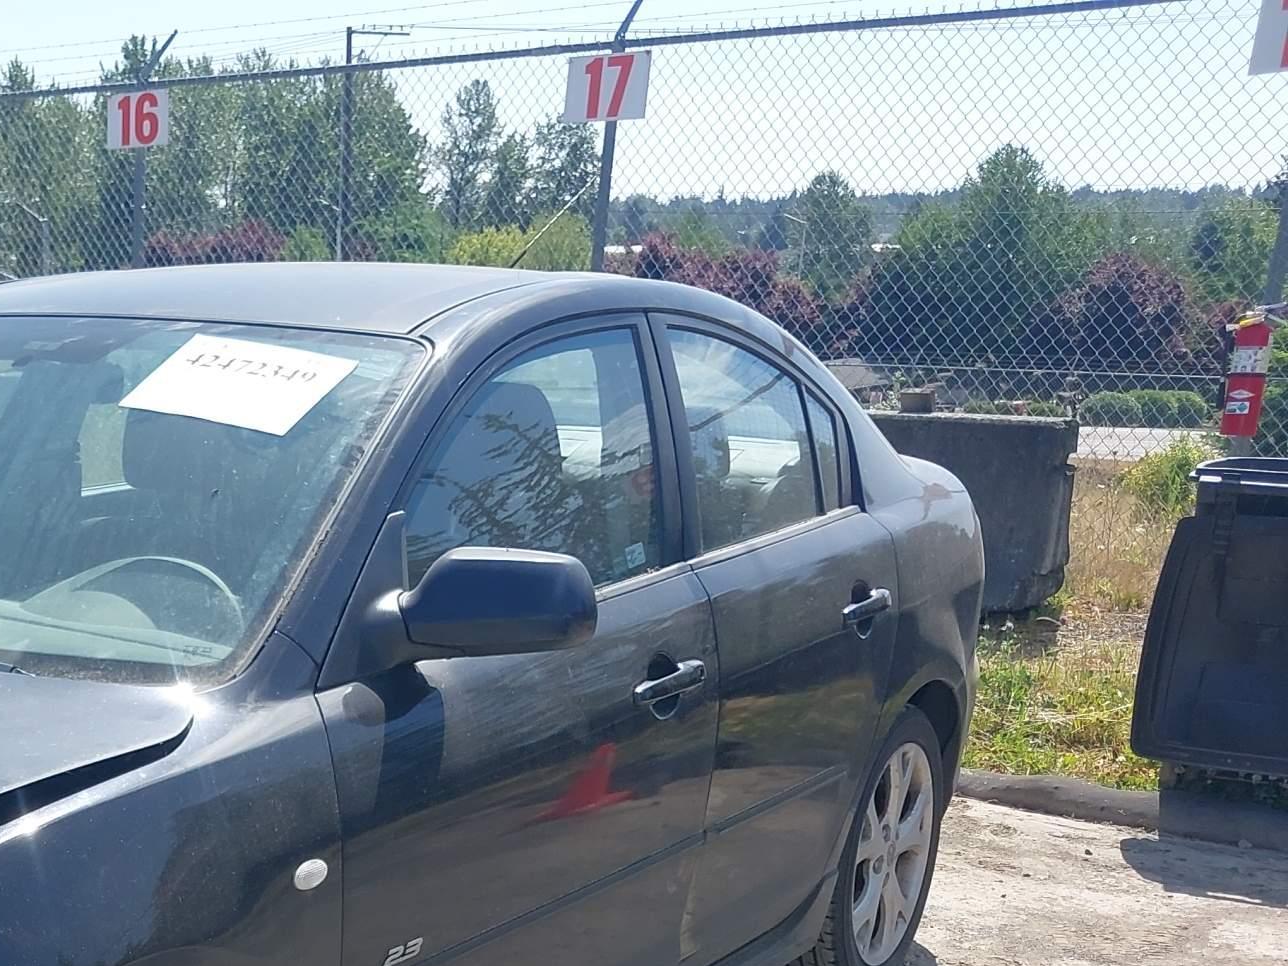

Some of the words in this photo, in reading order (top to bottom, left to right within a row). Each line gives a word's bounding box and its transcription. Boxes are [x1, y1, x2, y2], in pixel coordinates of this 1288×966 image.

[585, 54, 634, 119] 17
[118, 92, 159, 146] 16
[186, 353, 318, 382] 42472349
